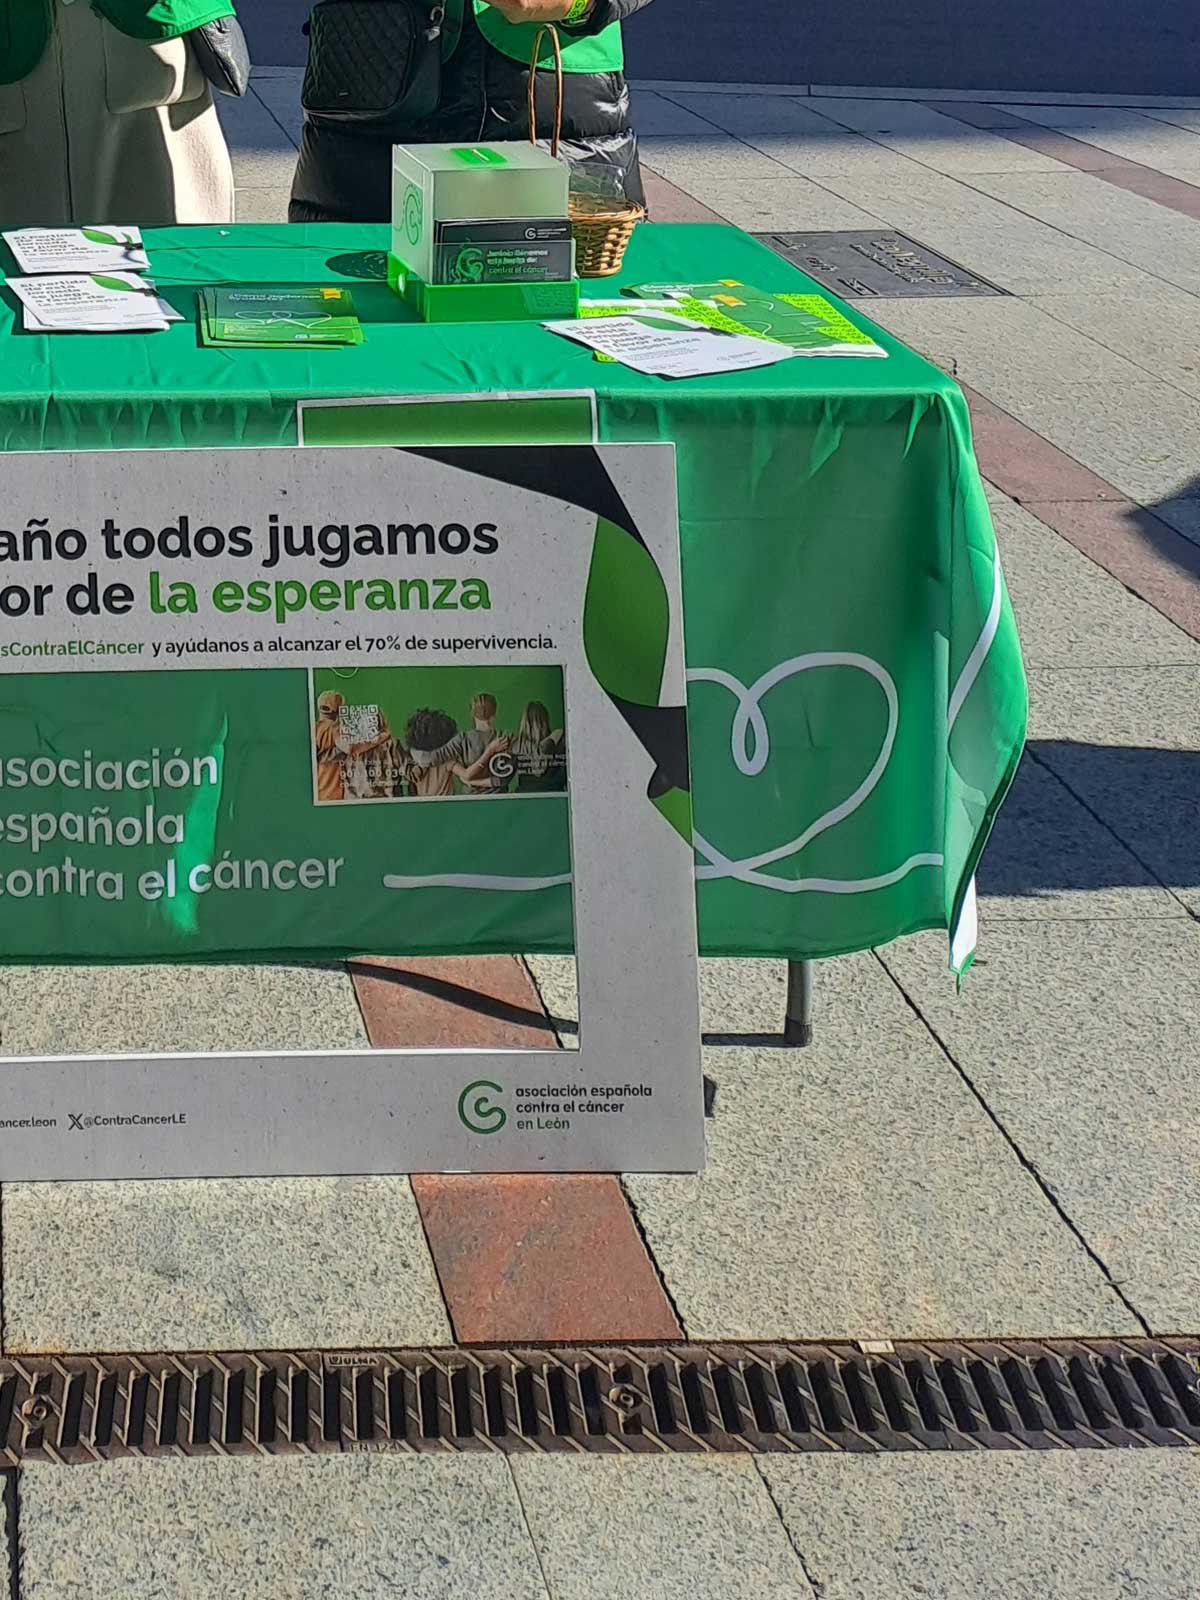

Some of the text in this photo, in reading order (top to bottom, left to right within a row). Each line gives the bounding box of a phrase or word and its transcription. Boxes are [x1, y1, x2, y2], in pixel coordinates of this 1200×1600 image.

[100, 515, 253, 559] todos
[261, 513, 499, 569] jugamos
[65, 571, 135, 616] de
[149, 571, 198, 614] la
[211, 576, 492, 624] esperanza
[152, 642, 161, 658] y
[165, 638, 249, 658] ayúdanos
[253, 640, 264, 652] a
[268, 637, 341, 653] alcanzar
[345, 636, 362, 651] el
[365, 635, 401, 654] 70%
[405, 634, 428, 650] de
[432, 633, 558, 654] supervivencia.
[137, 858, 177, 900] el
[188, 850, 345, 894] cáncer
[515, 1083, 652, 1100] asociación española
[516, 1100, 625, 1114] contra el cáncer
[517, 1117, 570, 1130] en León
